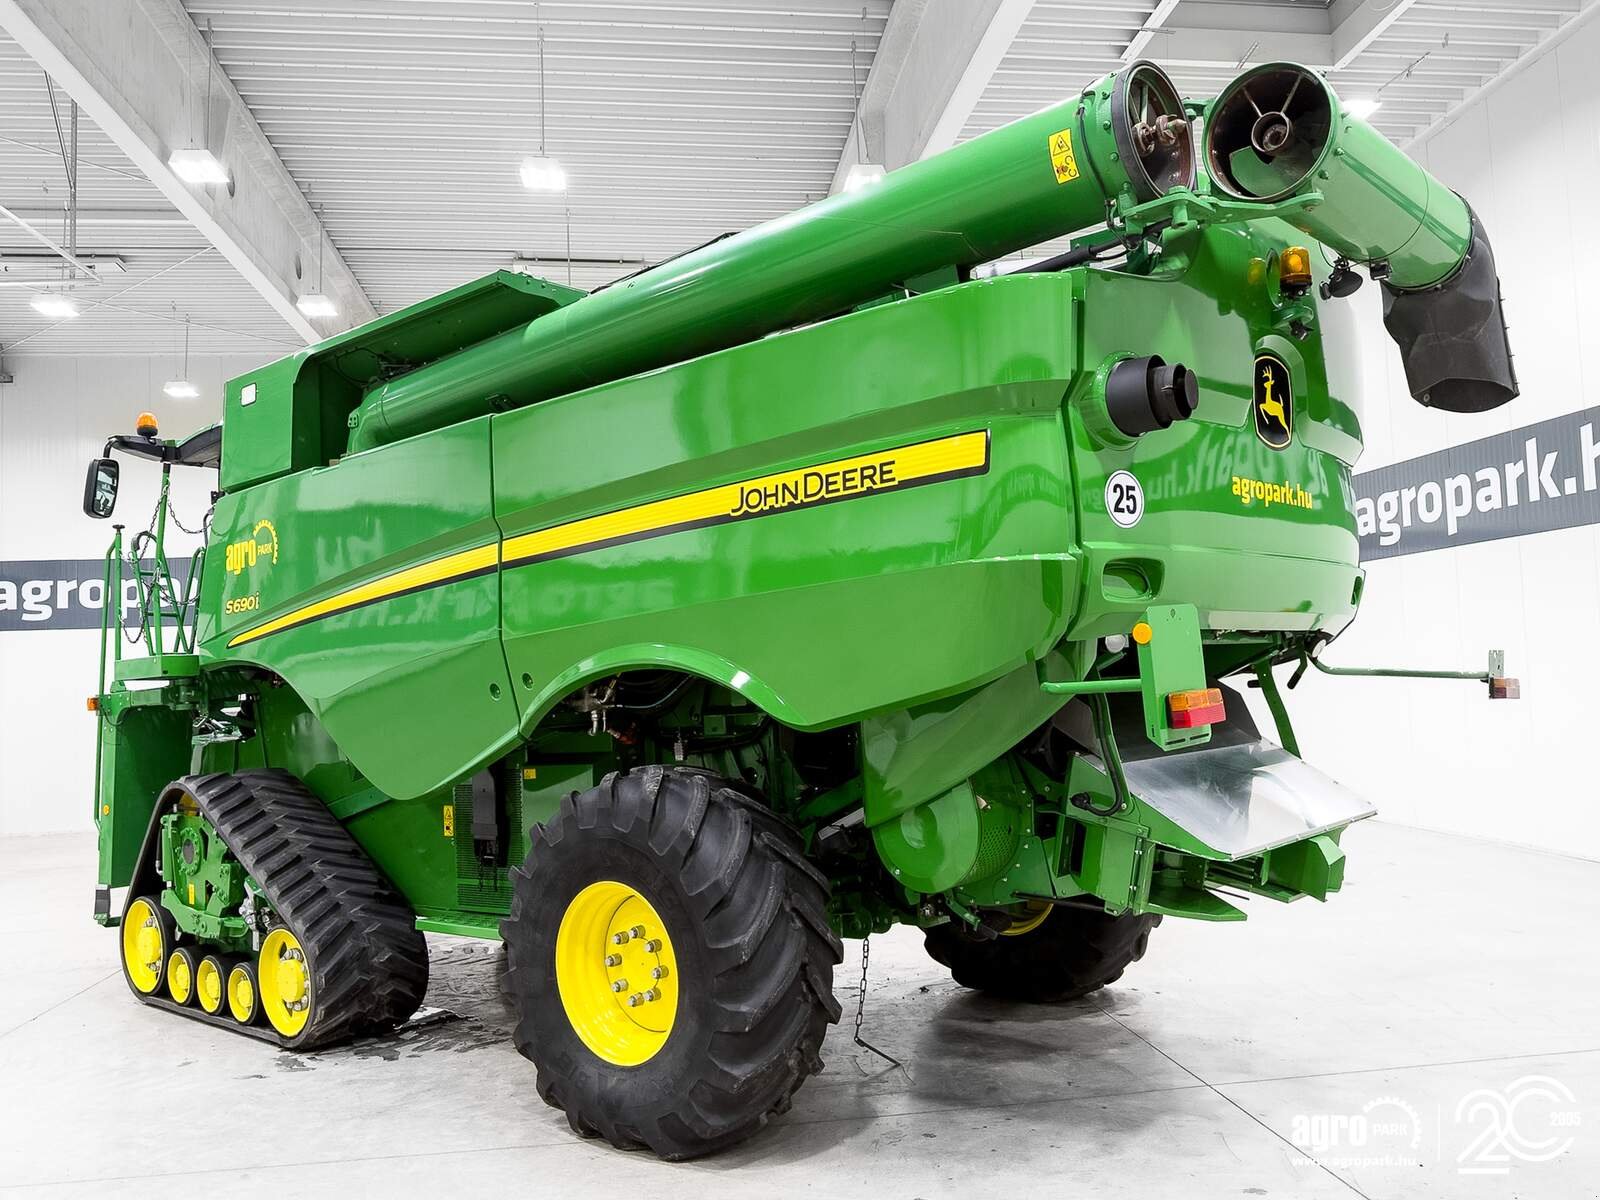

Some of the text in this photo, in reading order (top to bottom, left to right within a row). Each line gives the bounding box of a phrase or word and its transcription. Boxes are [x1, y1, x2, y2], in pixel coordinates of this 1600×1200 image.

[1112, 483, 1137, 515] 25
[1231, 475, 1313, 509] agropark.hu
[226, 539, 273, 575] agro PARK
[225, 592, 259, 614] S690i
